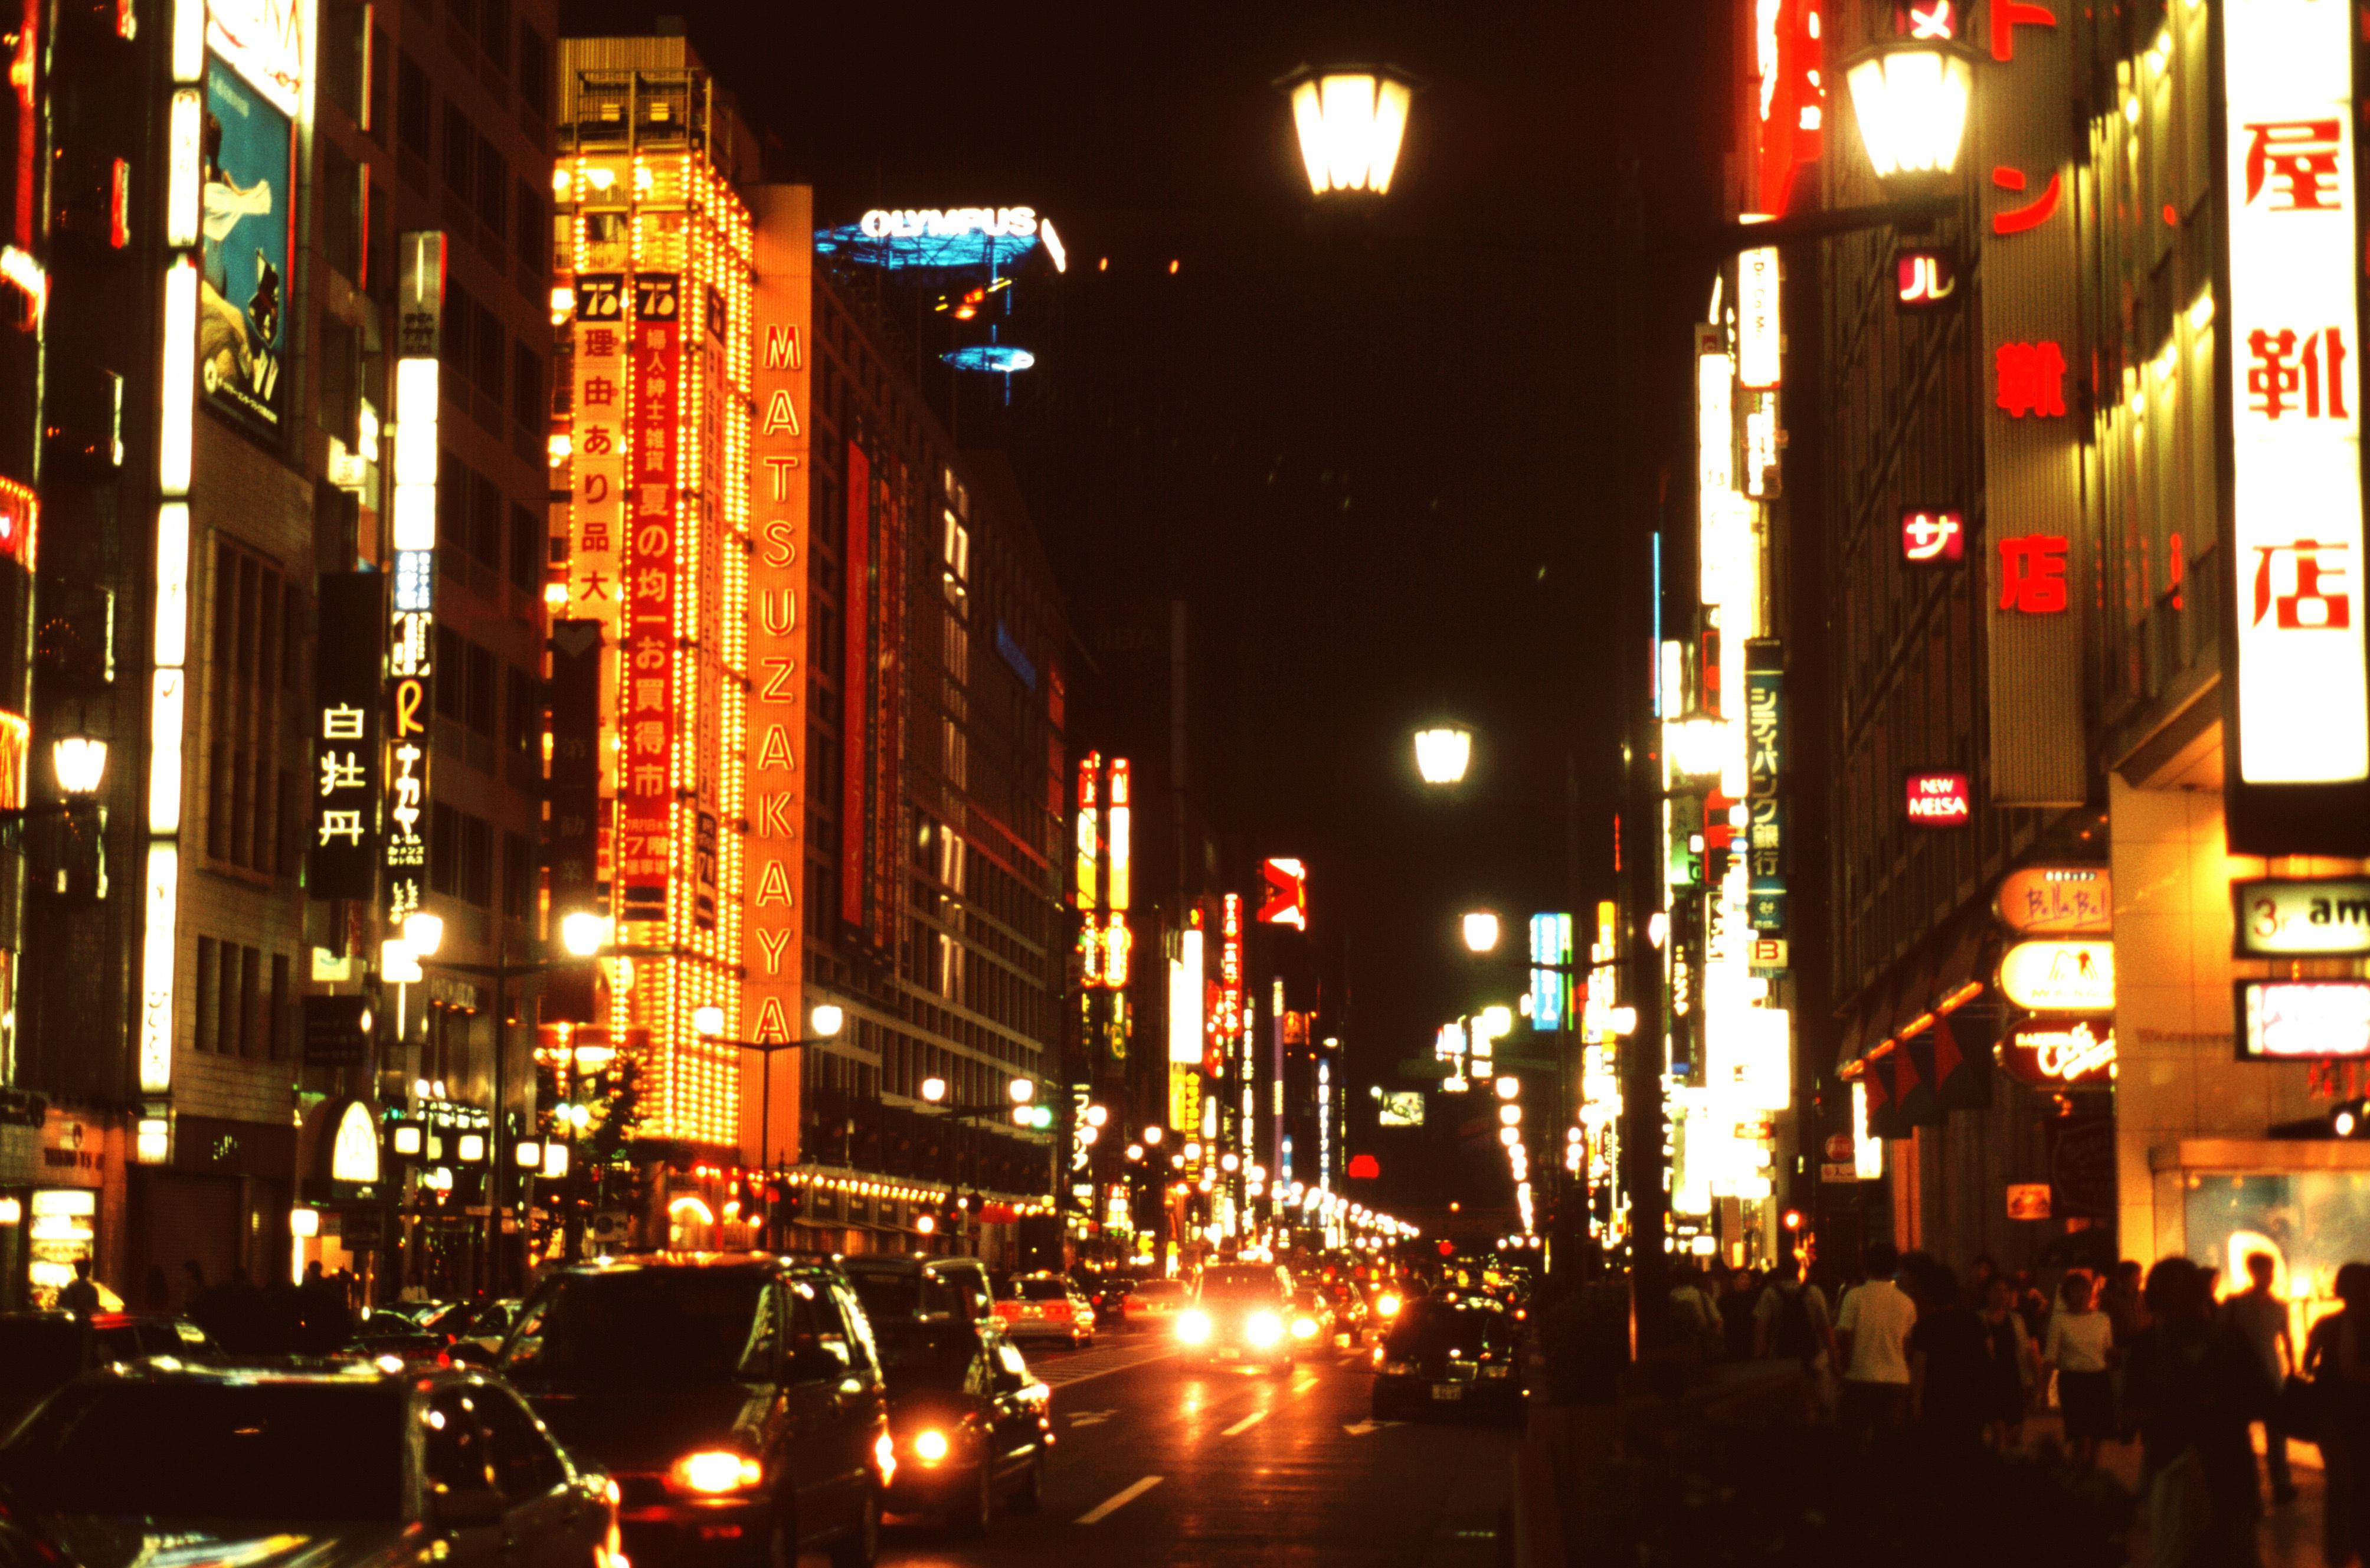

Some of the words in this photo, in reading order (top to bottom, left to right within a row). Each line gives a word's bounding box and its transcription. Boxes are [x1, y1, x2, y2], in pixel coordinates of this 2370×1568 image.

[861, 207, 1037, 237] OLYMPUS
[580, 328, 615, 640] 理由あり品大
[397, 679, 424, 737] R
[754, 324, 800, 1044] MATSUZAKAYA
[319, 703, 367, 847] 白牡丹
[1750, 687, 1779, 878] シティバンク銀行
[1909, 793, 1968, 817] MELSA
[1920, 778, 1953, 793] NEW
